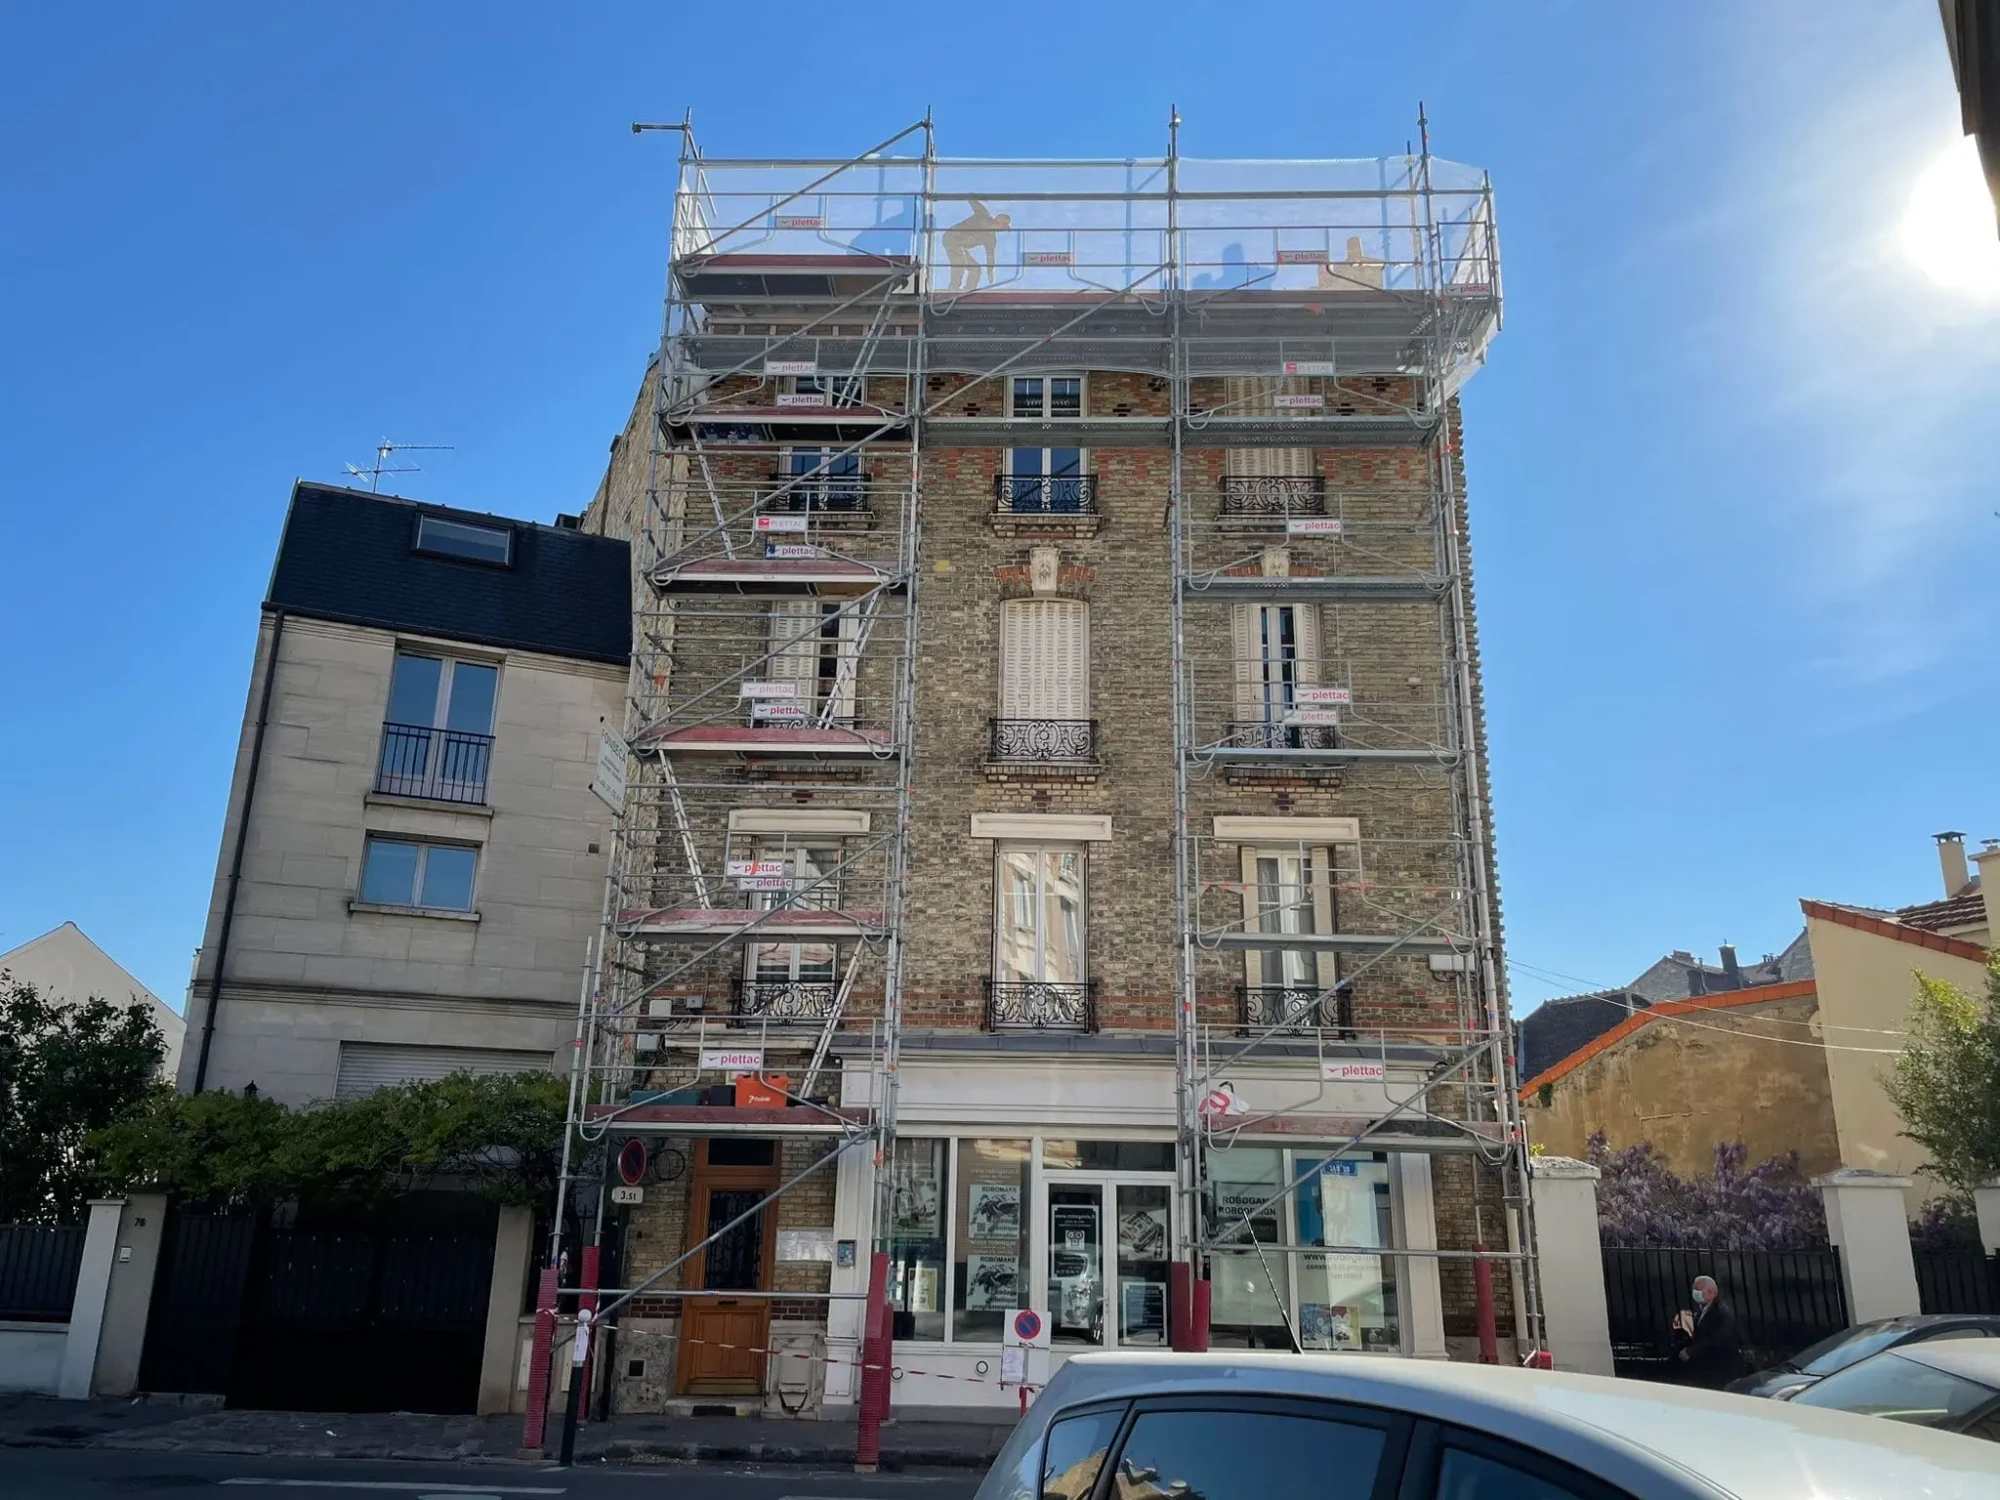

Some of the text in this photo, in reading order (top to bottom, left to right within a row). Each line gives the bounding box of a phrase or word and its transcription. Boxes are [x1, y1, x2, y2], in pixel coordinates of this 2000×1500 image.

[791, 217, 824, 228] plettac
[1039, 253, 1072, 263] plettac
[1294, 251, 1328, 261] plettac
[1460, 284, 1489, 294] plettac
[781, 363, 814, 373] plettac
[791, 395, 823, 405] plettac
[1289, 397, 1322, 406] plettac
[770, 519, 803, 527] PLETTAC
[1304, 520, 1340, 531] plettac
[781, 546, 815, 556] plettac
[759, 682, 794, 695] plettac
[1311, 691, 1349, 701] plettac
[1300, 710, 1337, 722] plettac
[744, 863, 781, 874] pettac
[756, 878, 792, 889] plettac
[720, 1052, 761, 1065] plettac
[1342, 1066, 1383, 1078] plettac
[1222, 1196, 1276, 1205] ROBOGAM
